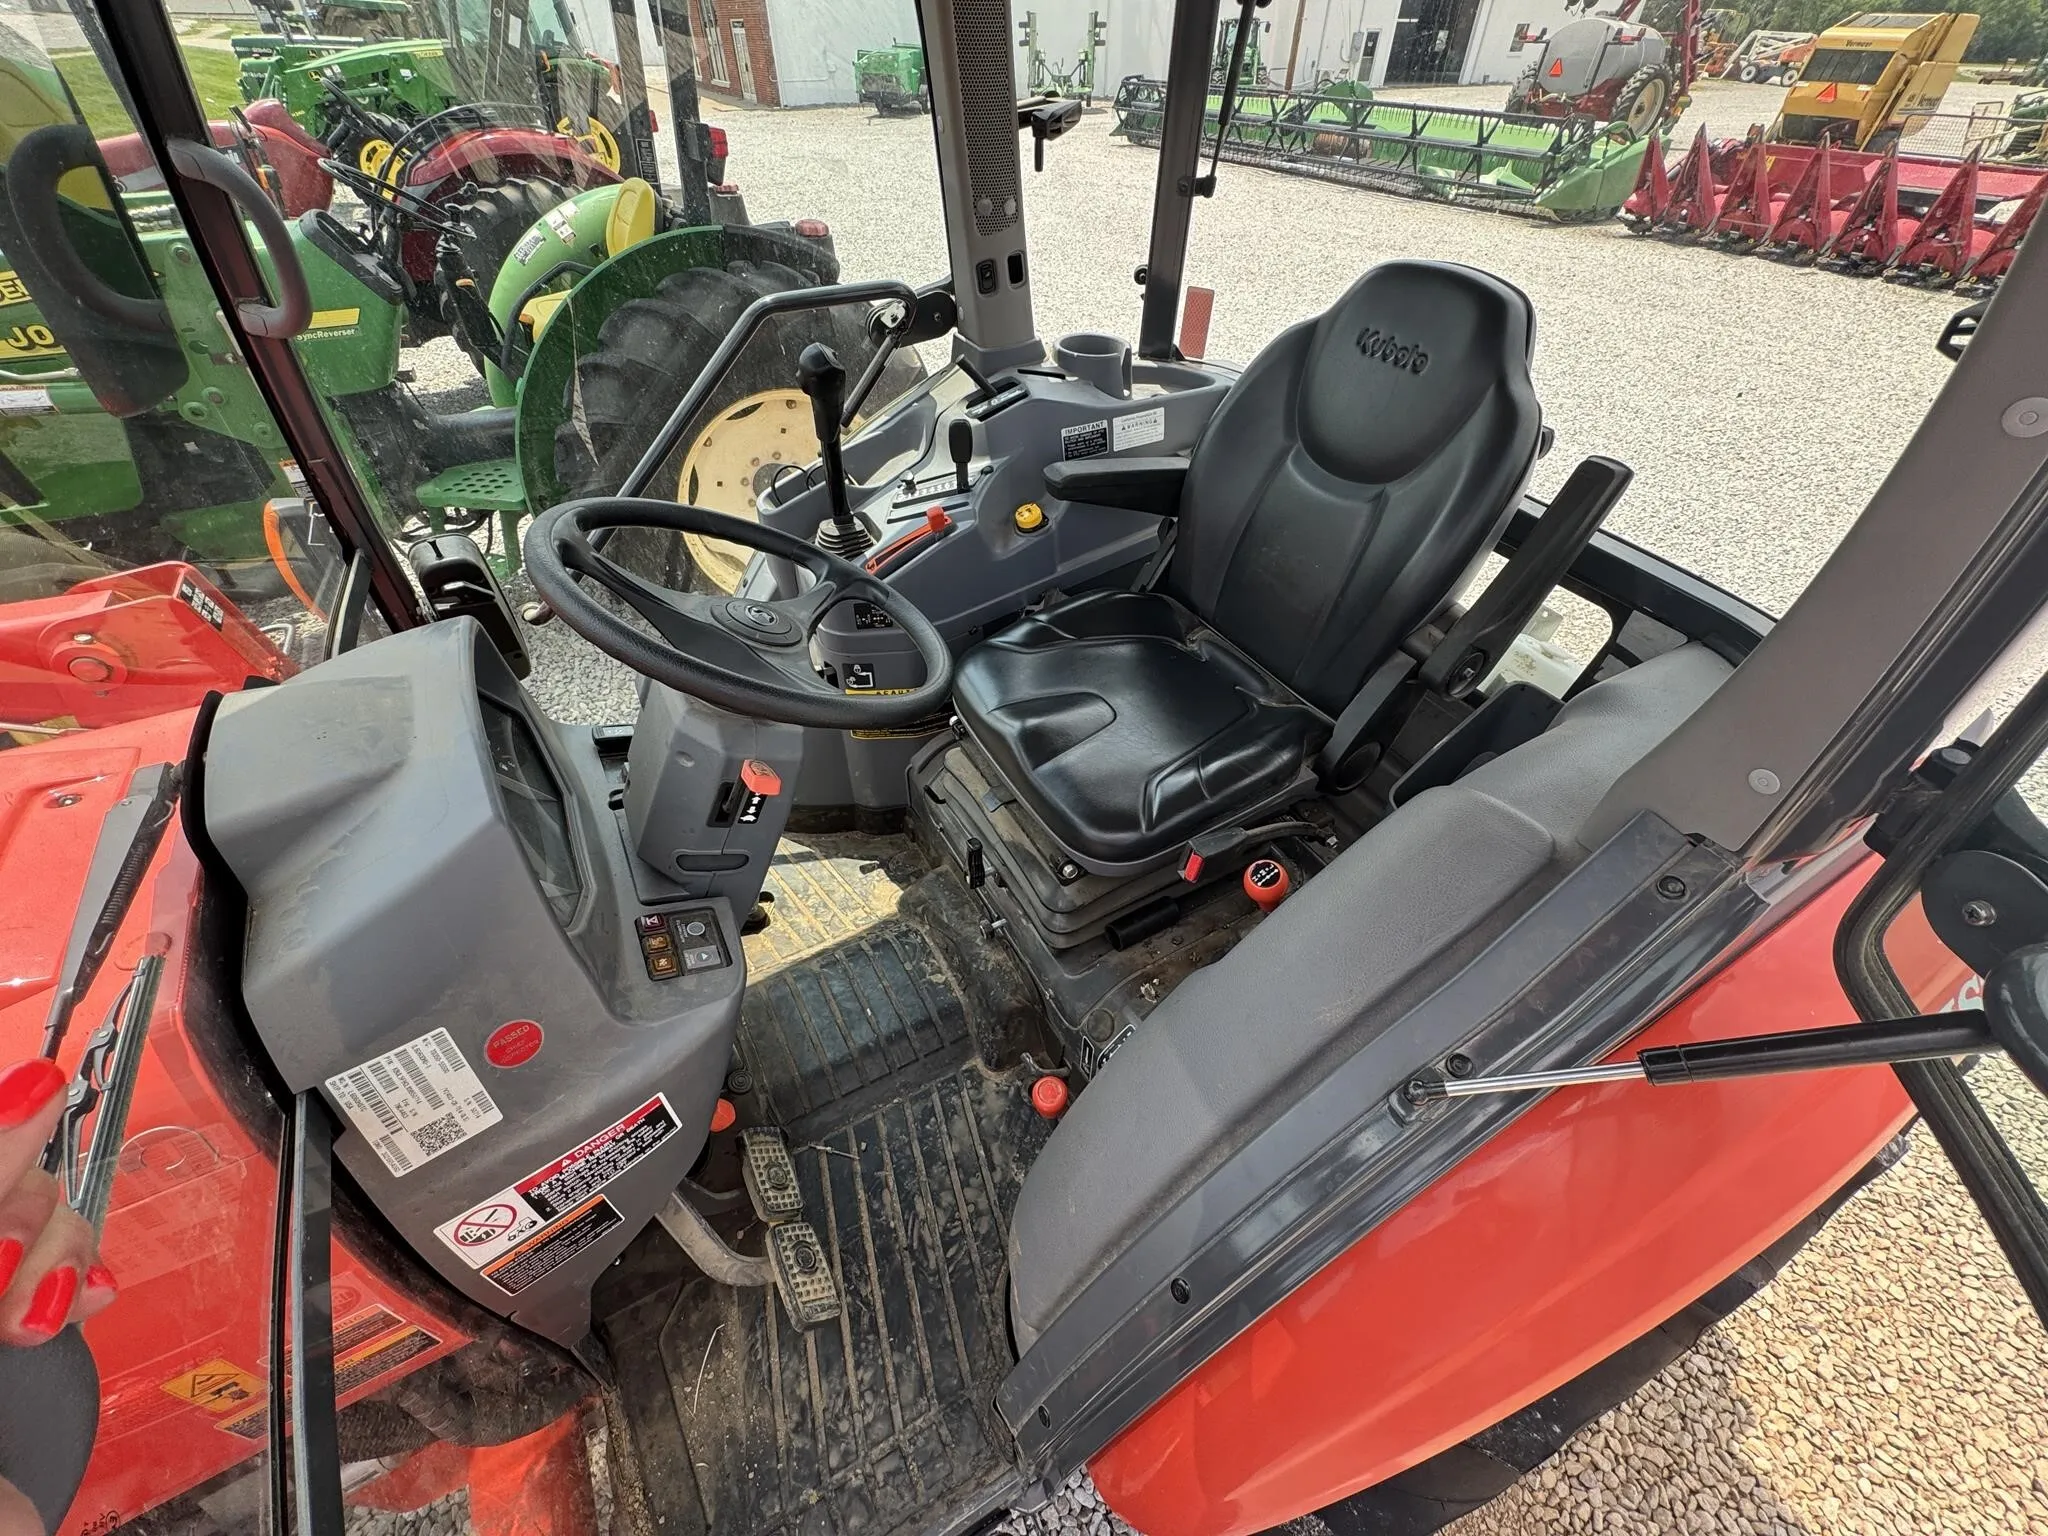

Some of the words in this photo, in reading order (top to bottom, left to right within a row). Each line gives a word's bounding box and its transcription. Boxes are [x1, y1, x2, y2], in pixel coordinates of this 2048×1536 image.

[1356, 326, 1430, 376] Kubota
[1065, 421, 1104, 435] IMPORTANT
[493, 1024, 530, 1049] PASSED
[540, 1172, 560, 1187] AVOID
[625, 1117, 645, 1132] DEATH
[574, 1122, 625, 1159] DANGER
